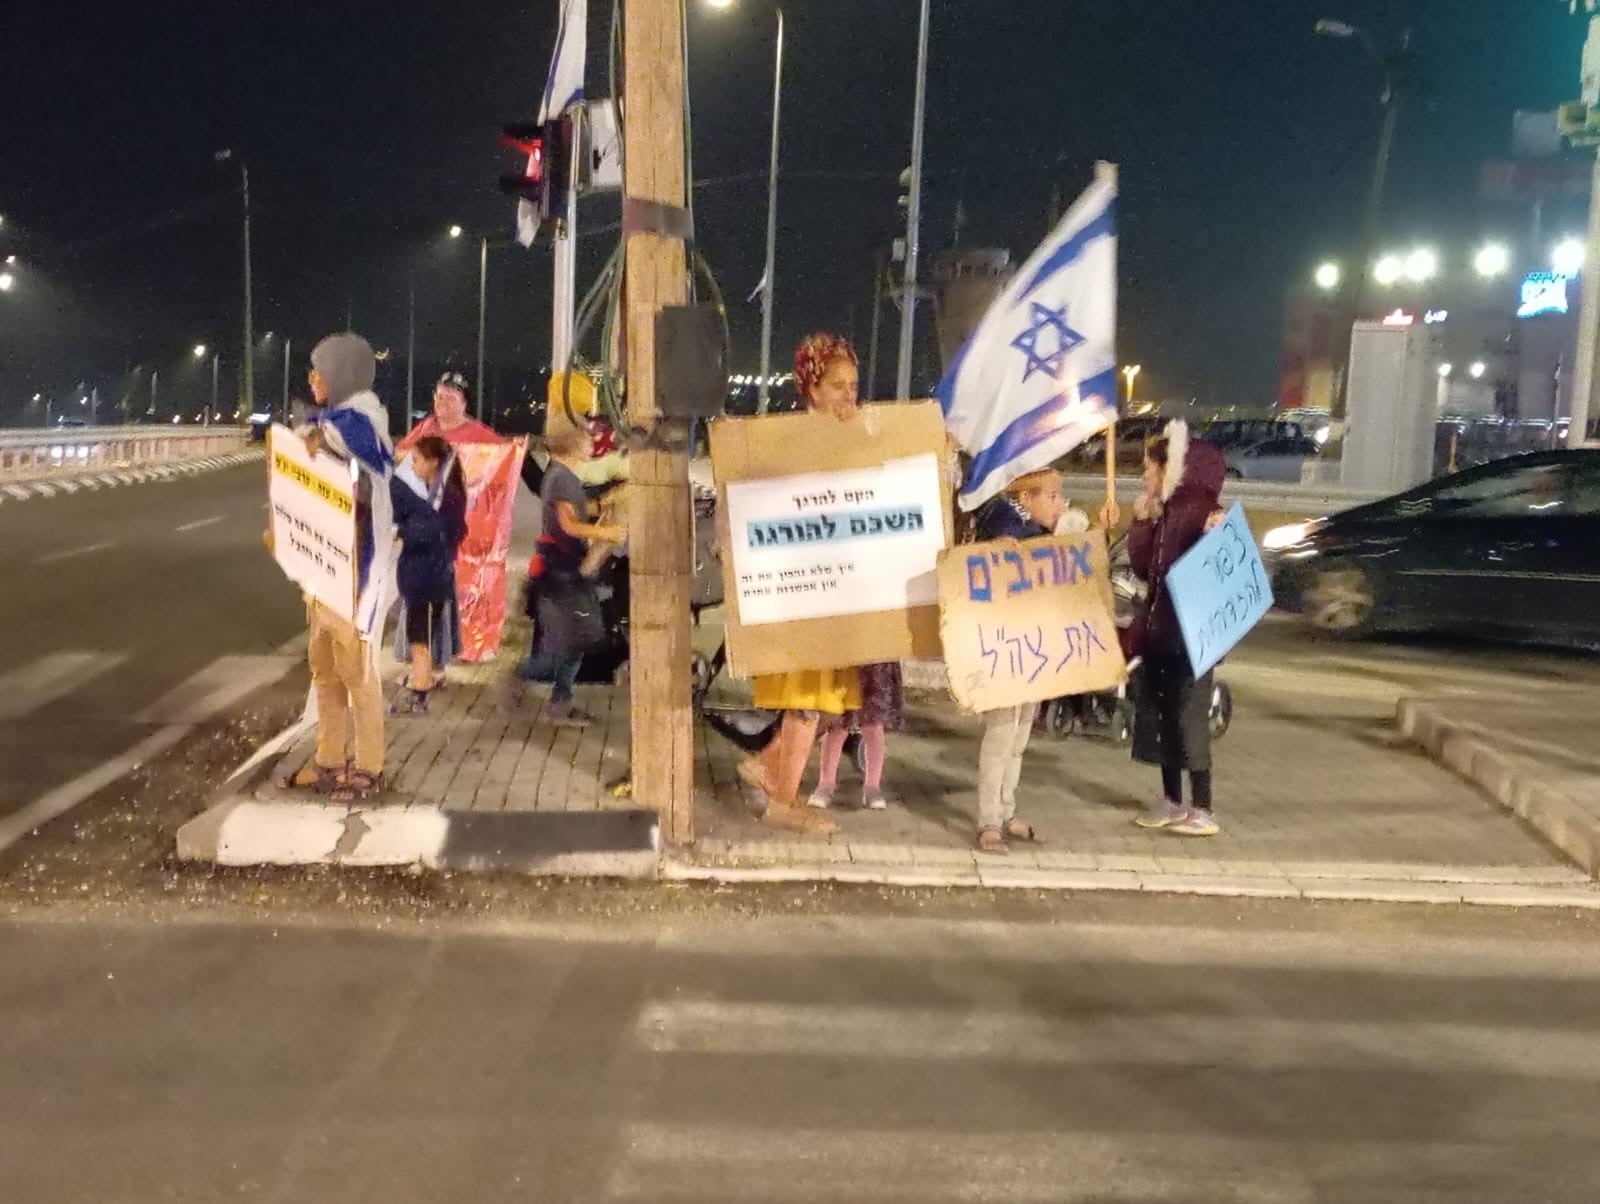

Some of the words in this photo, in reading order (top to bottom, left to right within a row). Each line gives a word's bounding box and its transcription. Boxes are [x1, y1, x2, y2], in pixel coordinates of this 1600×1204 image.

[844, 489, 875, 505] הקם
[850, 511, 924, 536] השכם
[810, 564, 832, 576] שלא
[966, 541, 1093, 602] אוהבים
[776, 582, 817, 595] אפשרות
[821, 580, 837, 591] אין
[978, 623, 1049, 684] צה"ל
[1056, 621, 1107, 674] את
